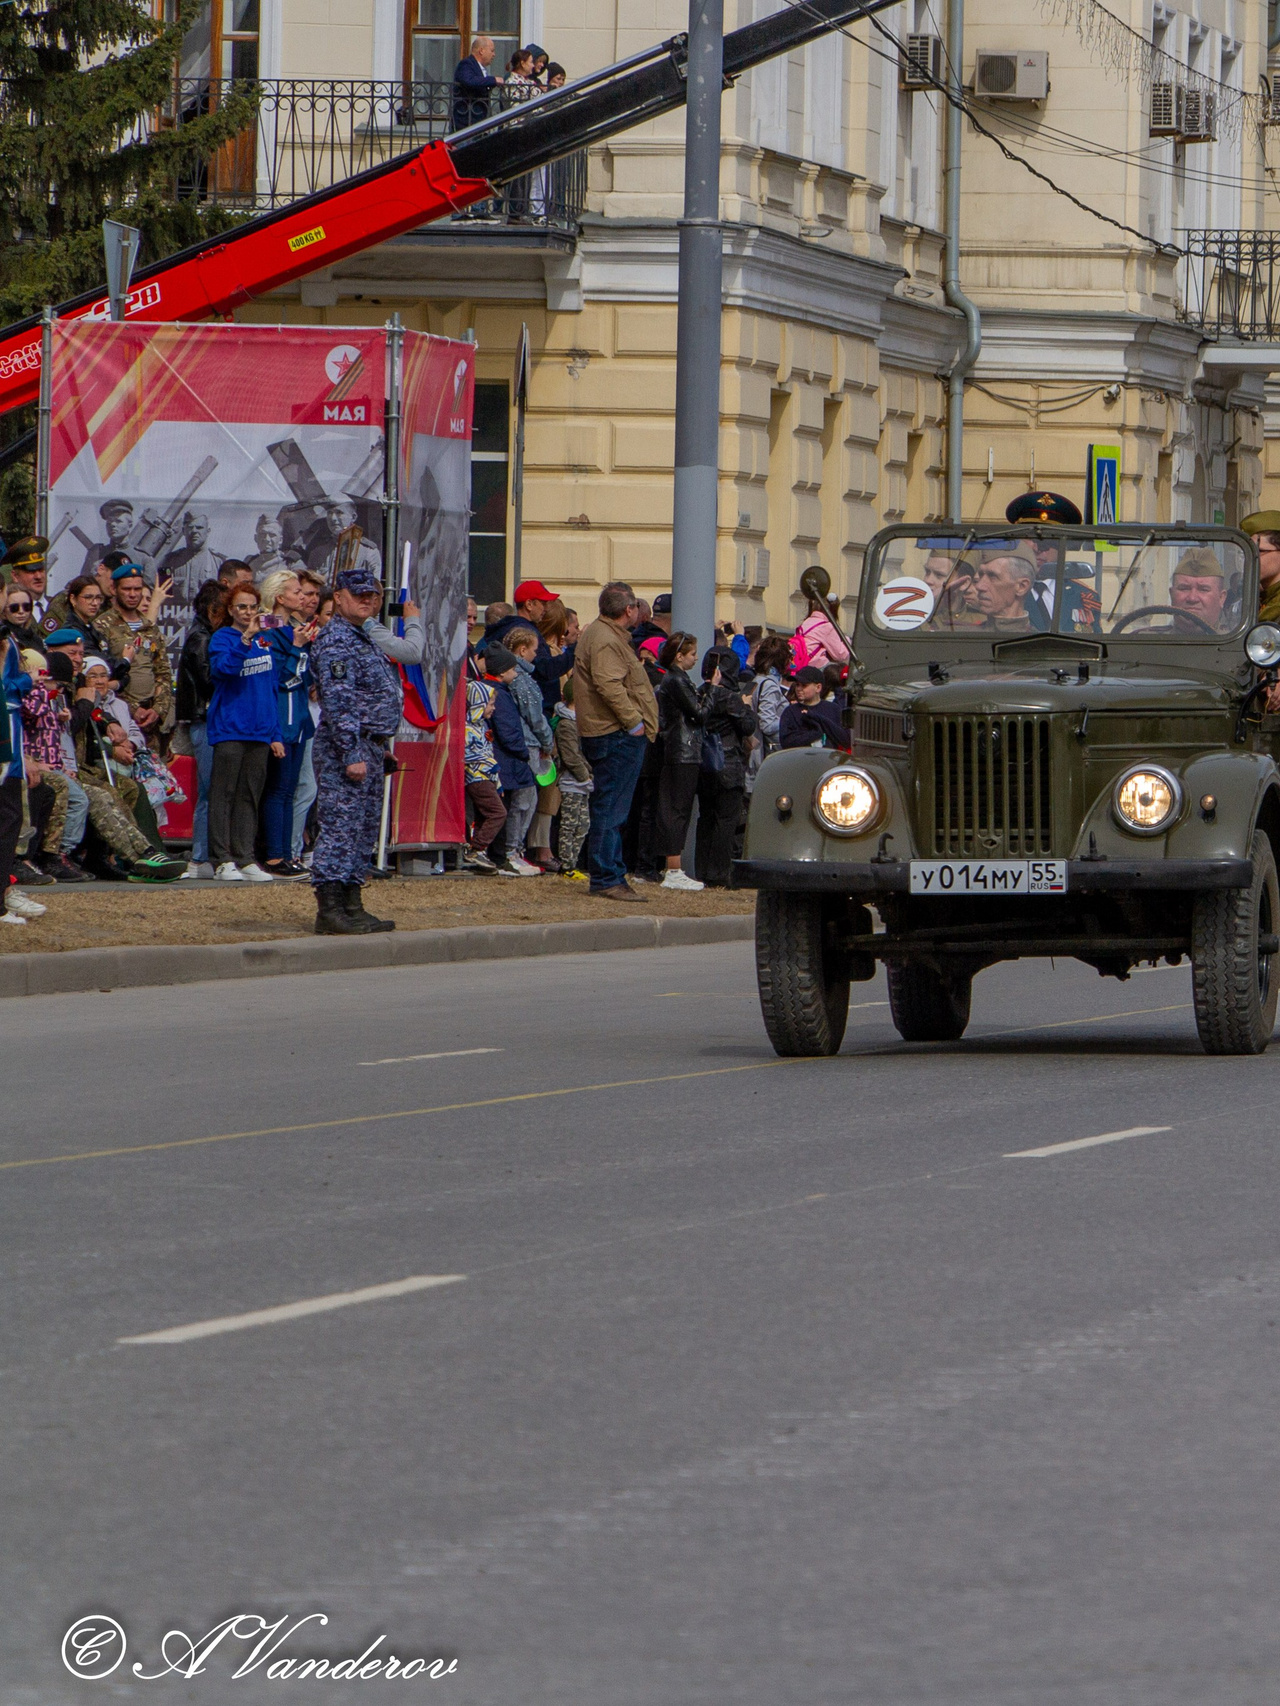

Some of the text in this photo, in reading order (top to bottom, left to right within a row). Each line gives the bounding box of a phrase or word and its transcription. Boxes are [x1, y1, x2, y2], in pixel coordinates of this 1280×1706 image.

[291, 232, 315, 248] 400 KG
[323, 405, 365, 421] МАЯ
[450, 418, 465, 433] МАЯ
[883, 586, 928, 618] Z
[1032, 863, 1056, 882] 55
